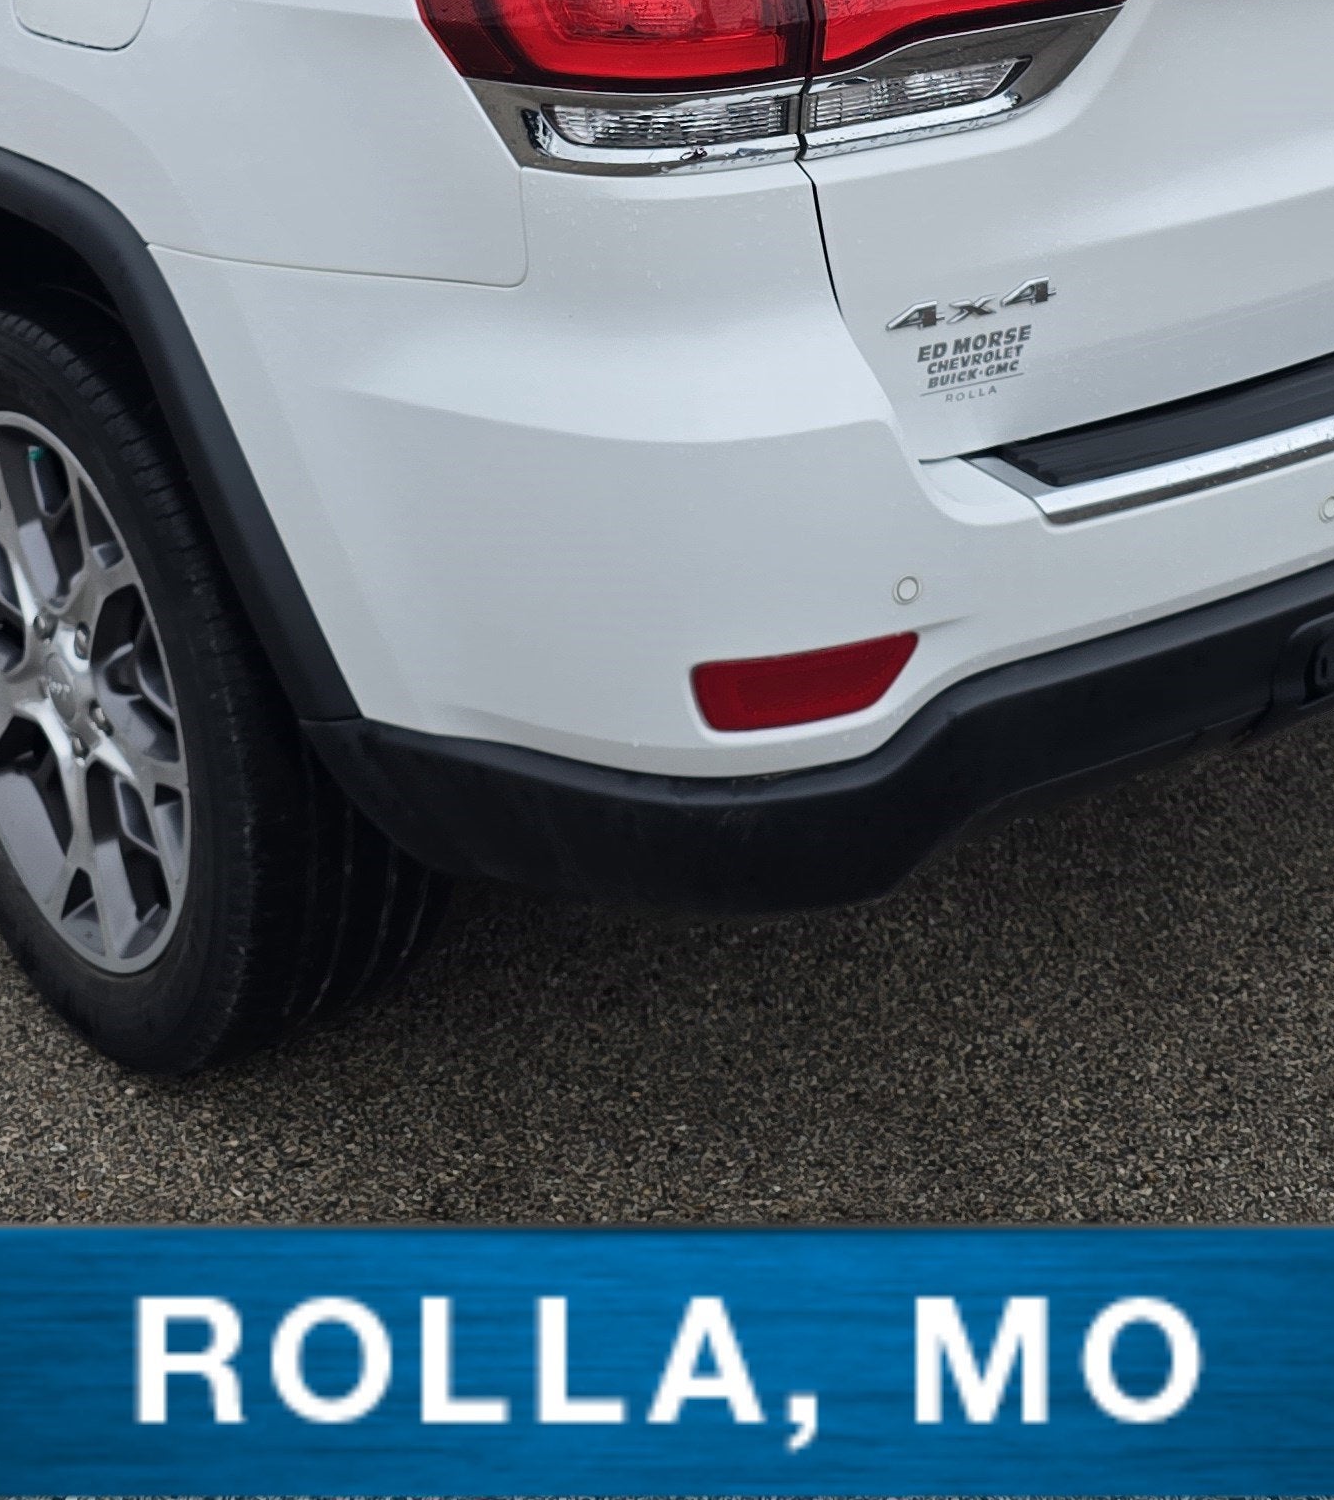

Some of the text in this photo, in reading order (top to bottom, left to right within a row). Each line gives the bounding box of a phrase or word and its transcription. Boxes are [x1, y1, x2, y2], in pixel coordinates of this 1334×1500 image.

[917, 324, 1032, 363] ED MORSE
[927, 344, 1024, 375] CHEVROLET
[945, 385, 998, 403] ROLLA
